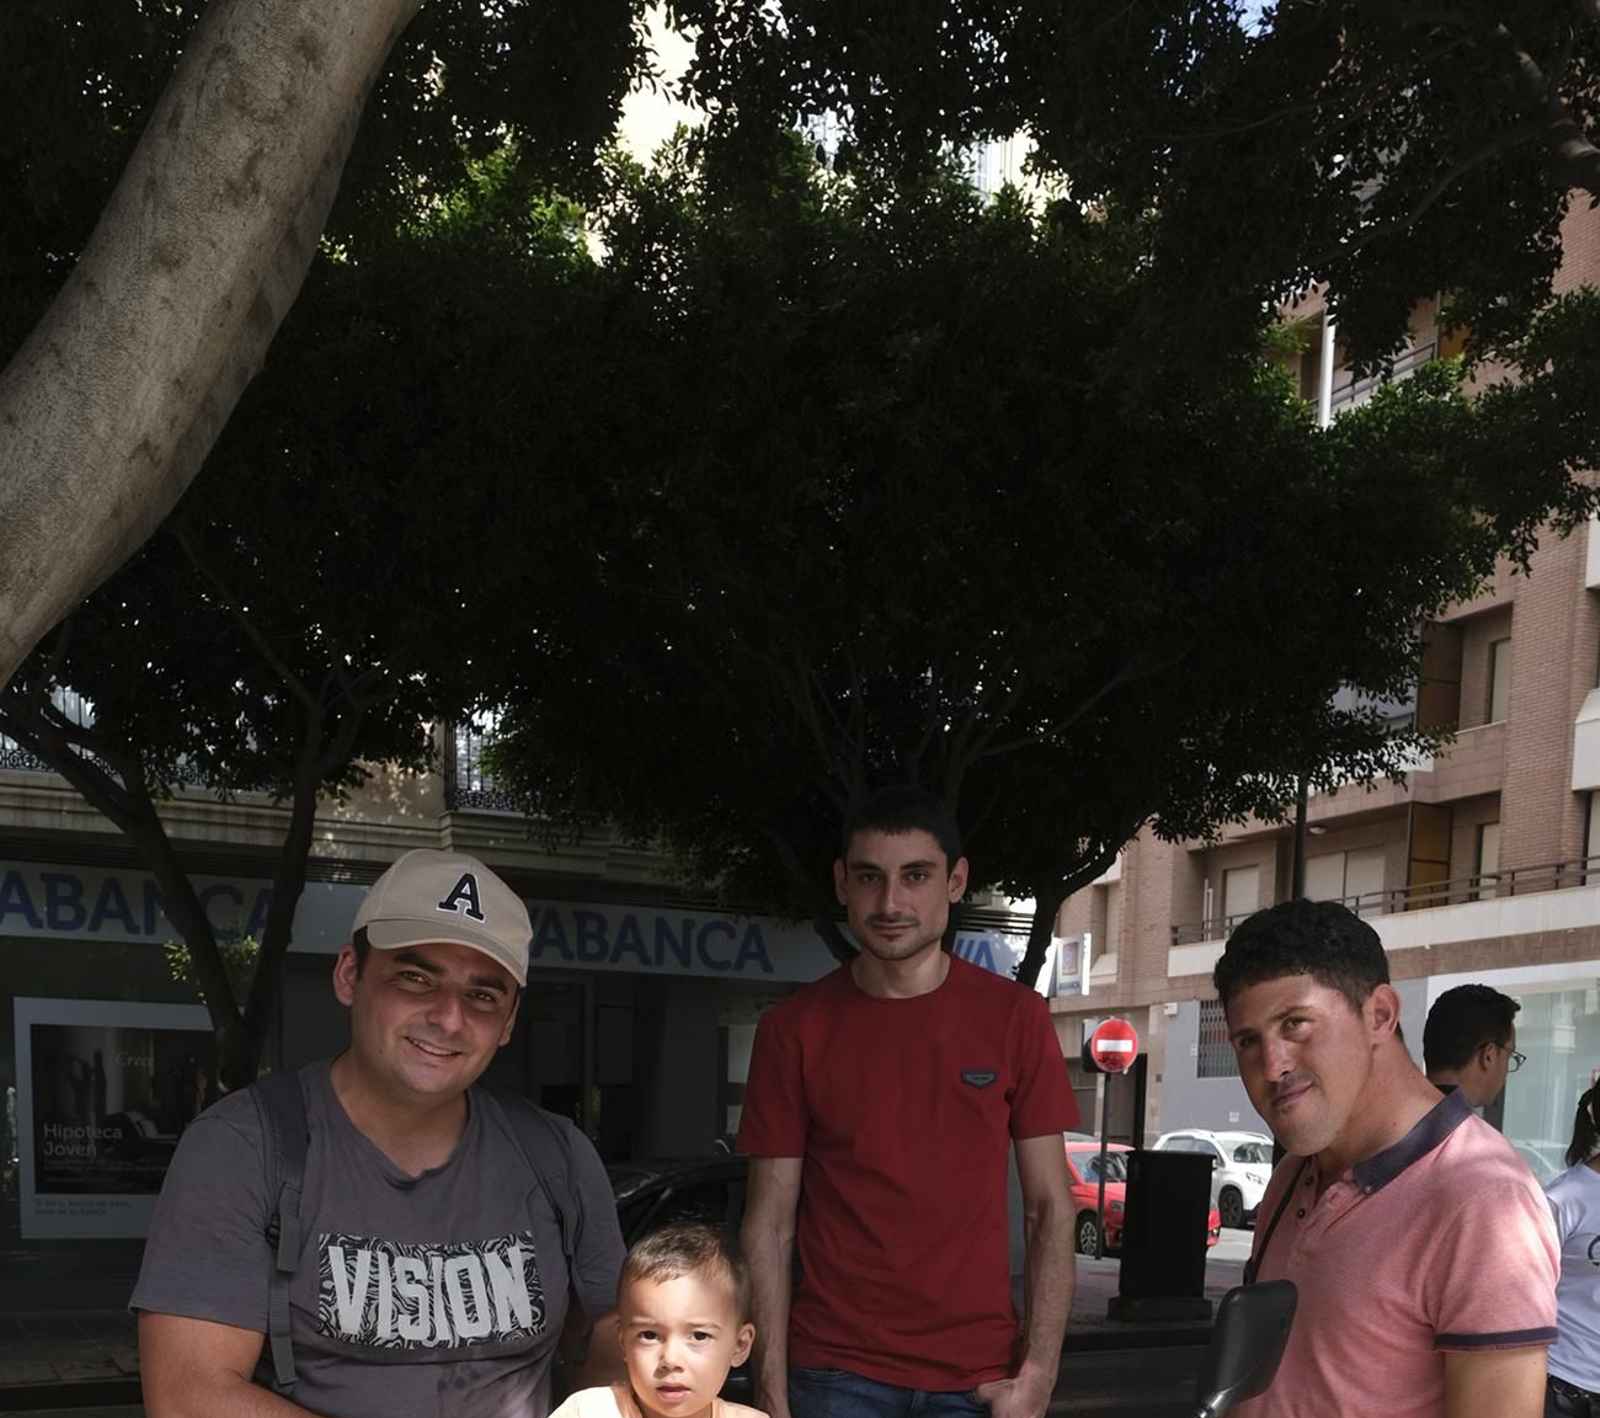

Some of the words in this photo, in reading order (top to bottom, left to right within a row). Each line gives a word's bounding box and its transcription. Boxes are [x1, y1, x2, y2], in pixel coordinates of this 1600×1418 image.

[437, 872, 486, 923] A
[531, 907, 774, 973] ABANCA
[44, 1123, 122, 1140] Hipoteca
[44, 1142, 97, 1156] Joven
[328, 1246, 533, 1341] VISION
